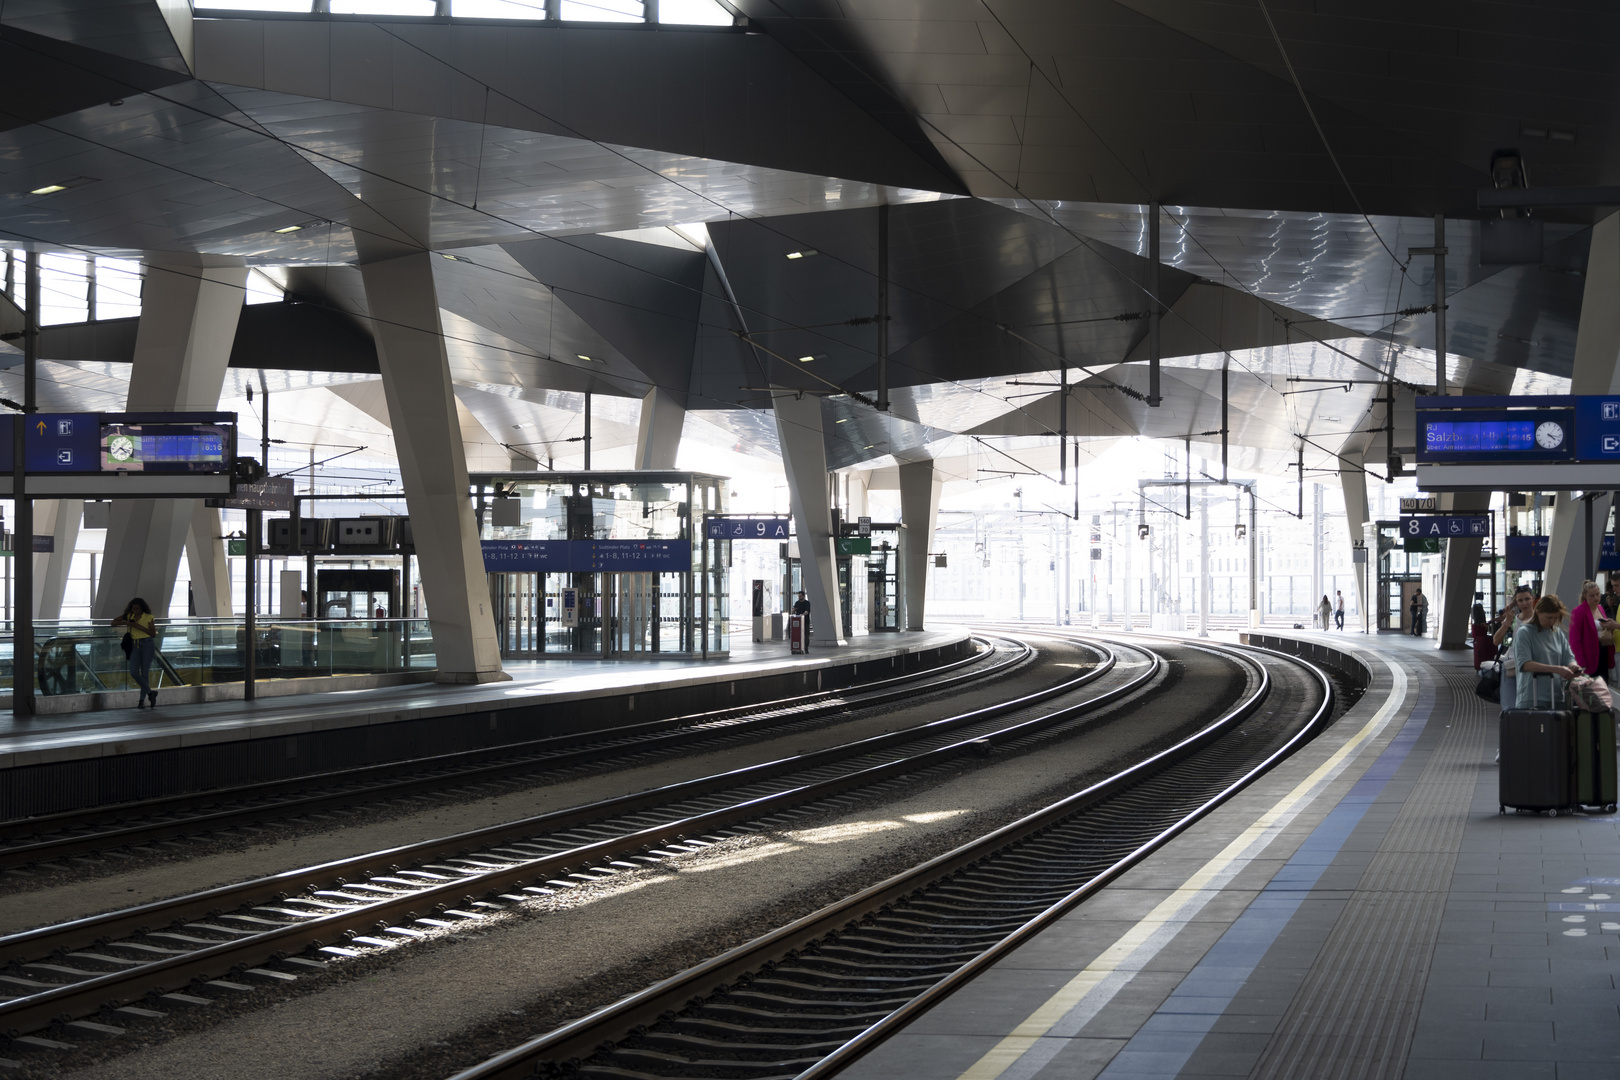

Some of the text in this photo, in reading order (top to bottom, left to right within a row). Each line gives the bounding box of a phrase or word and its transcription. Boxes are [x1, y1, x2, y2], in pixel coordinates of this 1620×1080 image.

[1426, 423, 1438, 431] RJ
[1426, 432, 1479, 442] Salzburg
[201, 443, 223, 451] 16:15
[1402, 499, 1415, 509] 140
[1421, 498, 1433, 509] 70
[756, 522, 785, 536] 9 A
[1408, 519, 1441, 535] 8 A
[484, 553, 498, 561] 1-8,
[605, 552, 620, 560] 1-8,
[622, 552, 641, 560] 11-12
